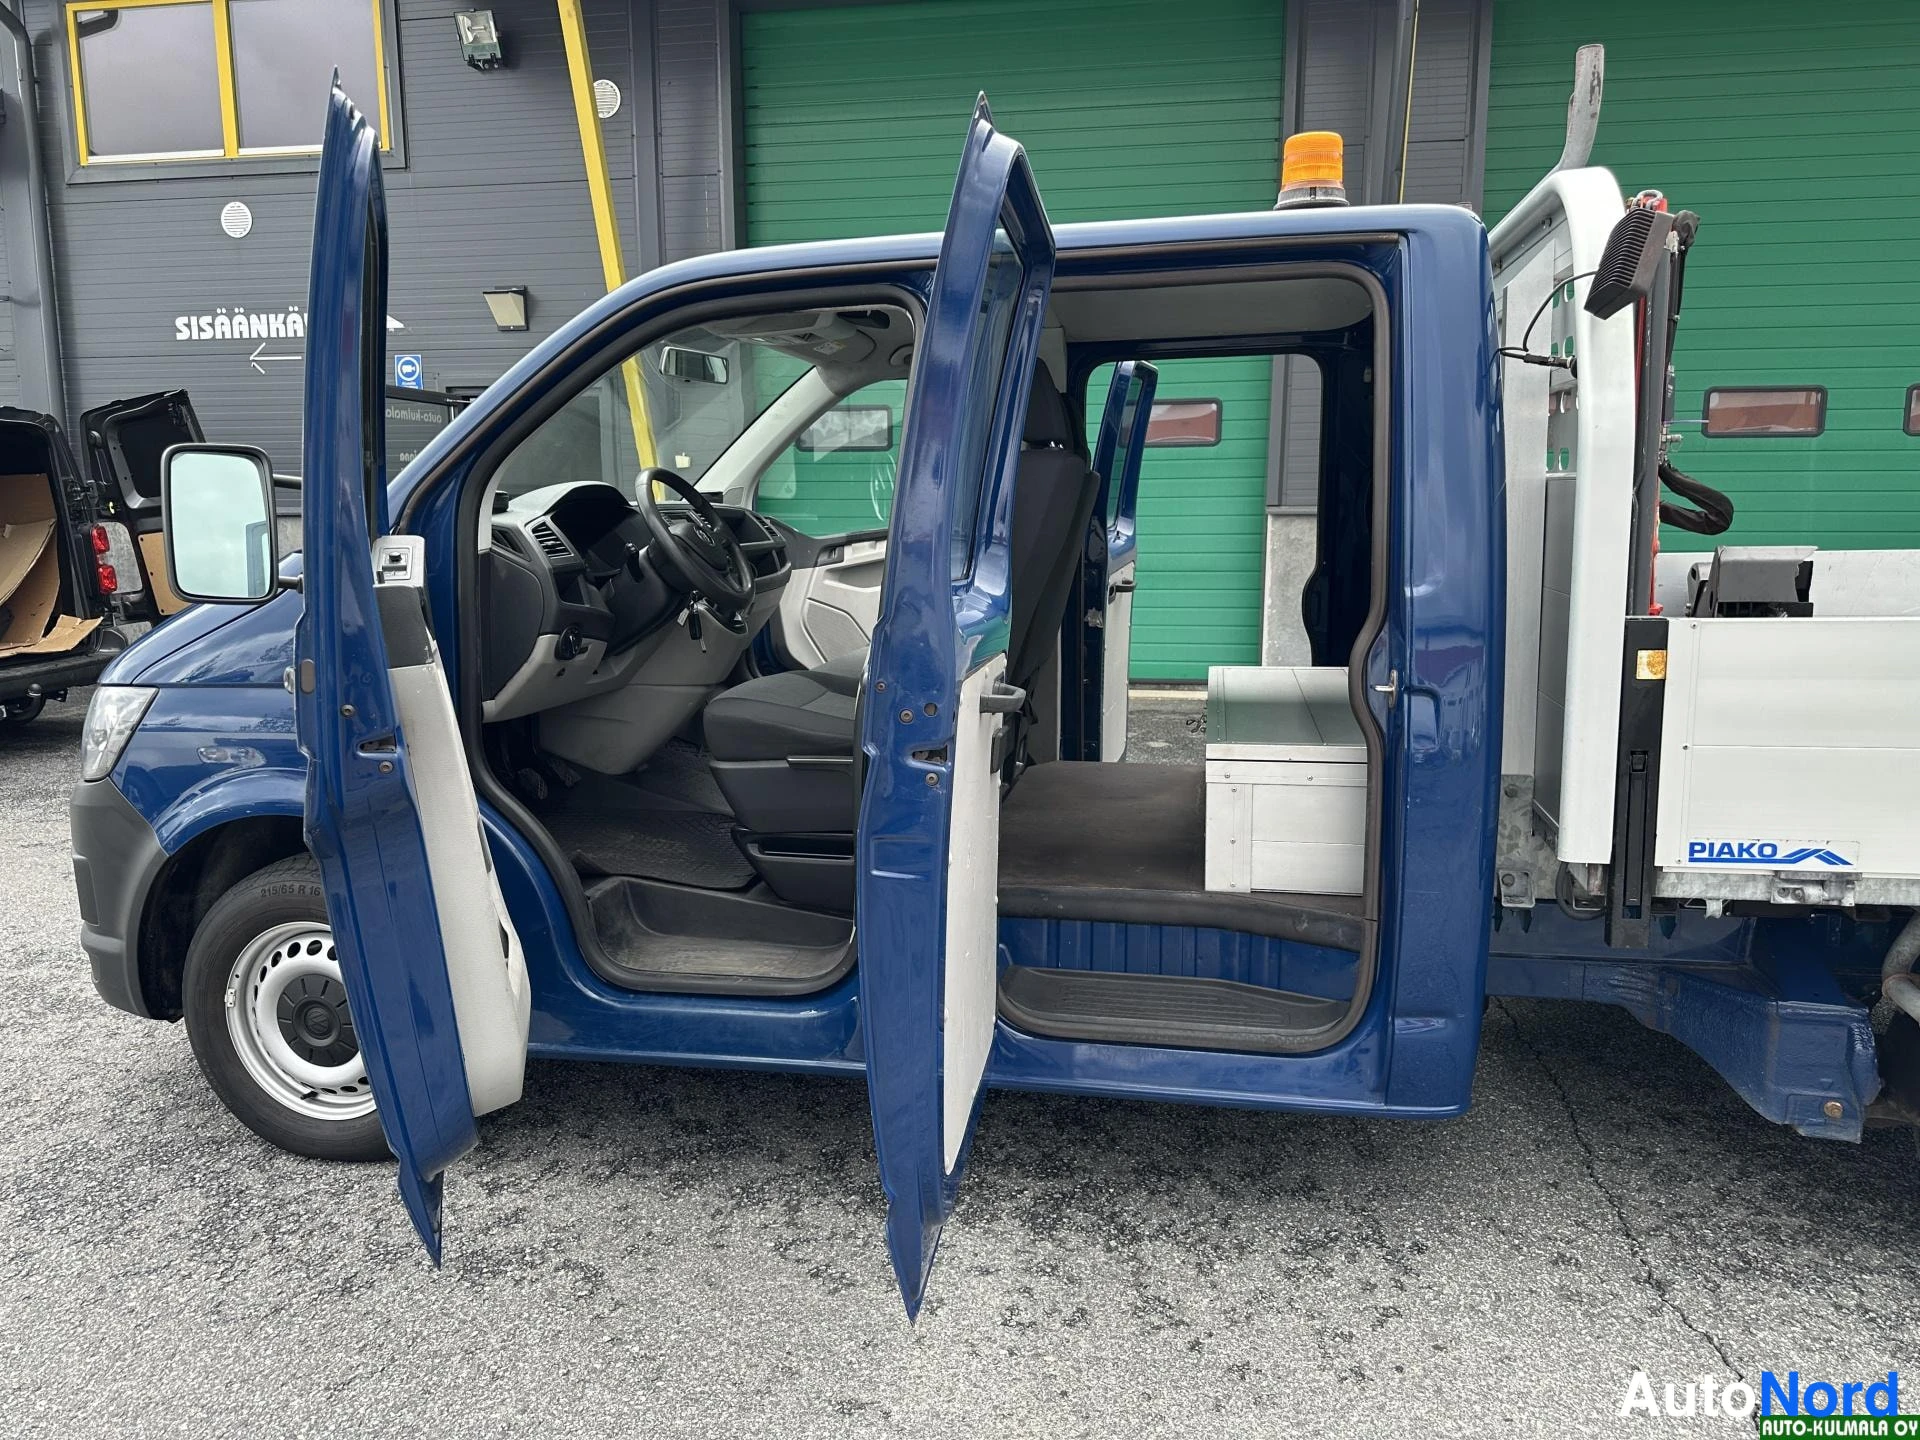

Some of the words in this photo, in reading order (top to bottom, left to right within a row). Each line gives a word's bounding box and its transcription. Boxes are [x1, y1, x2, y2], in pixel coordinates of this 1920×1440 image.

[175, 306, 308, 340] SISÄÄNKÄ
[1688, 841, 1778, 859] PIAKO
[297, 885, 306, 896] R
